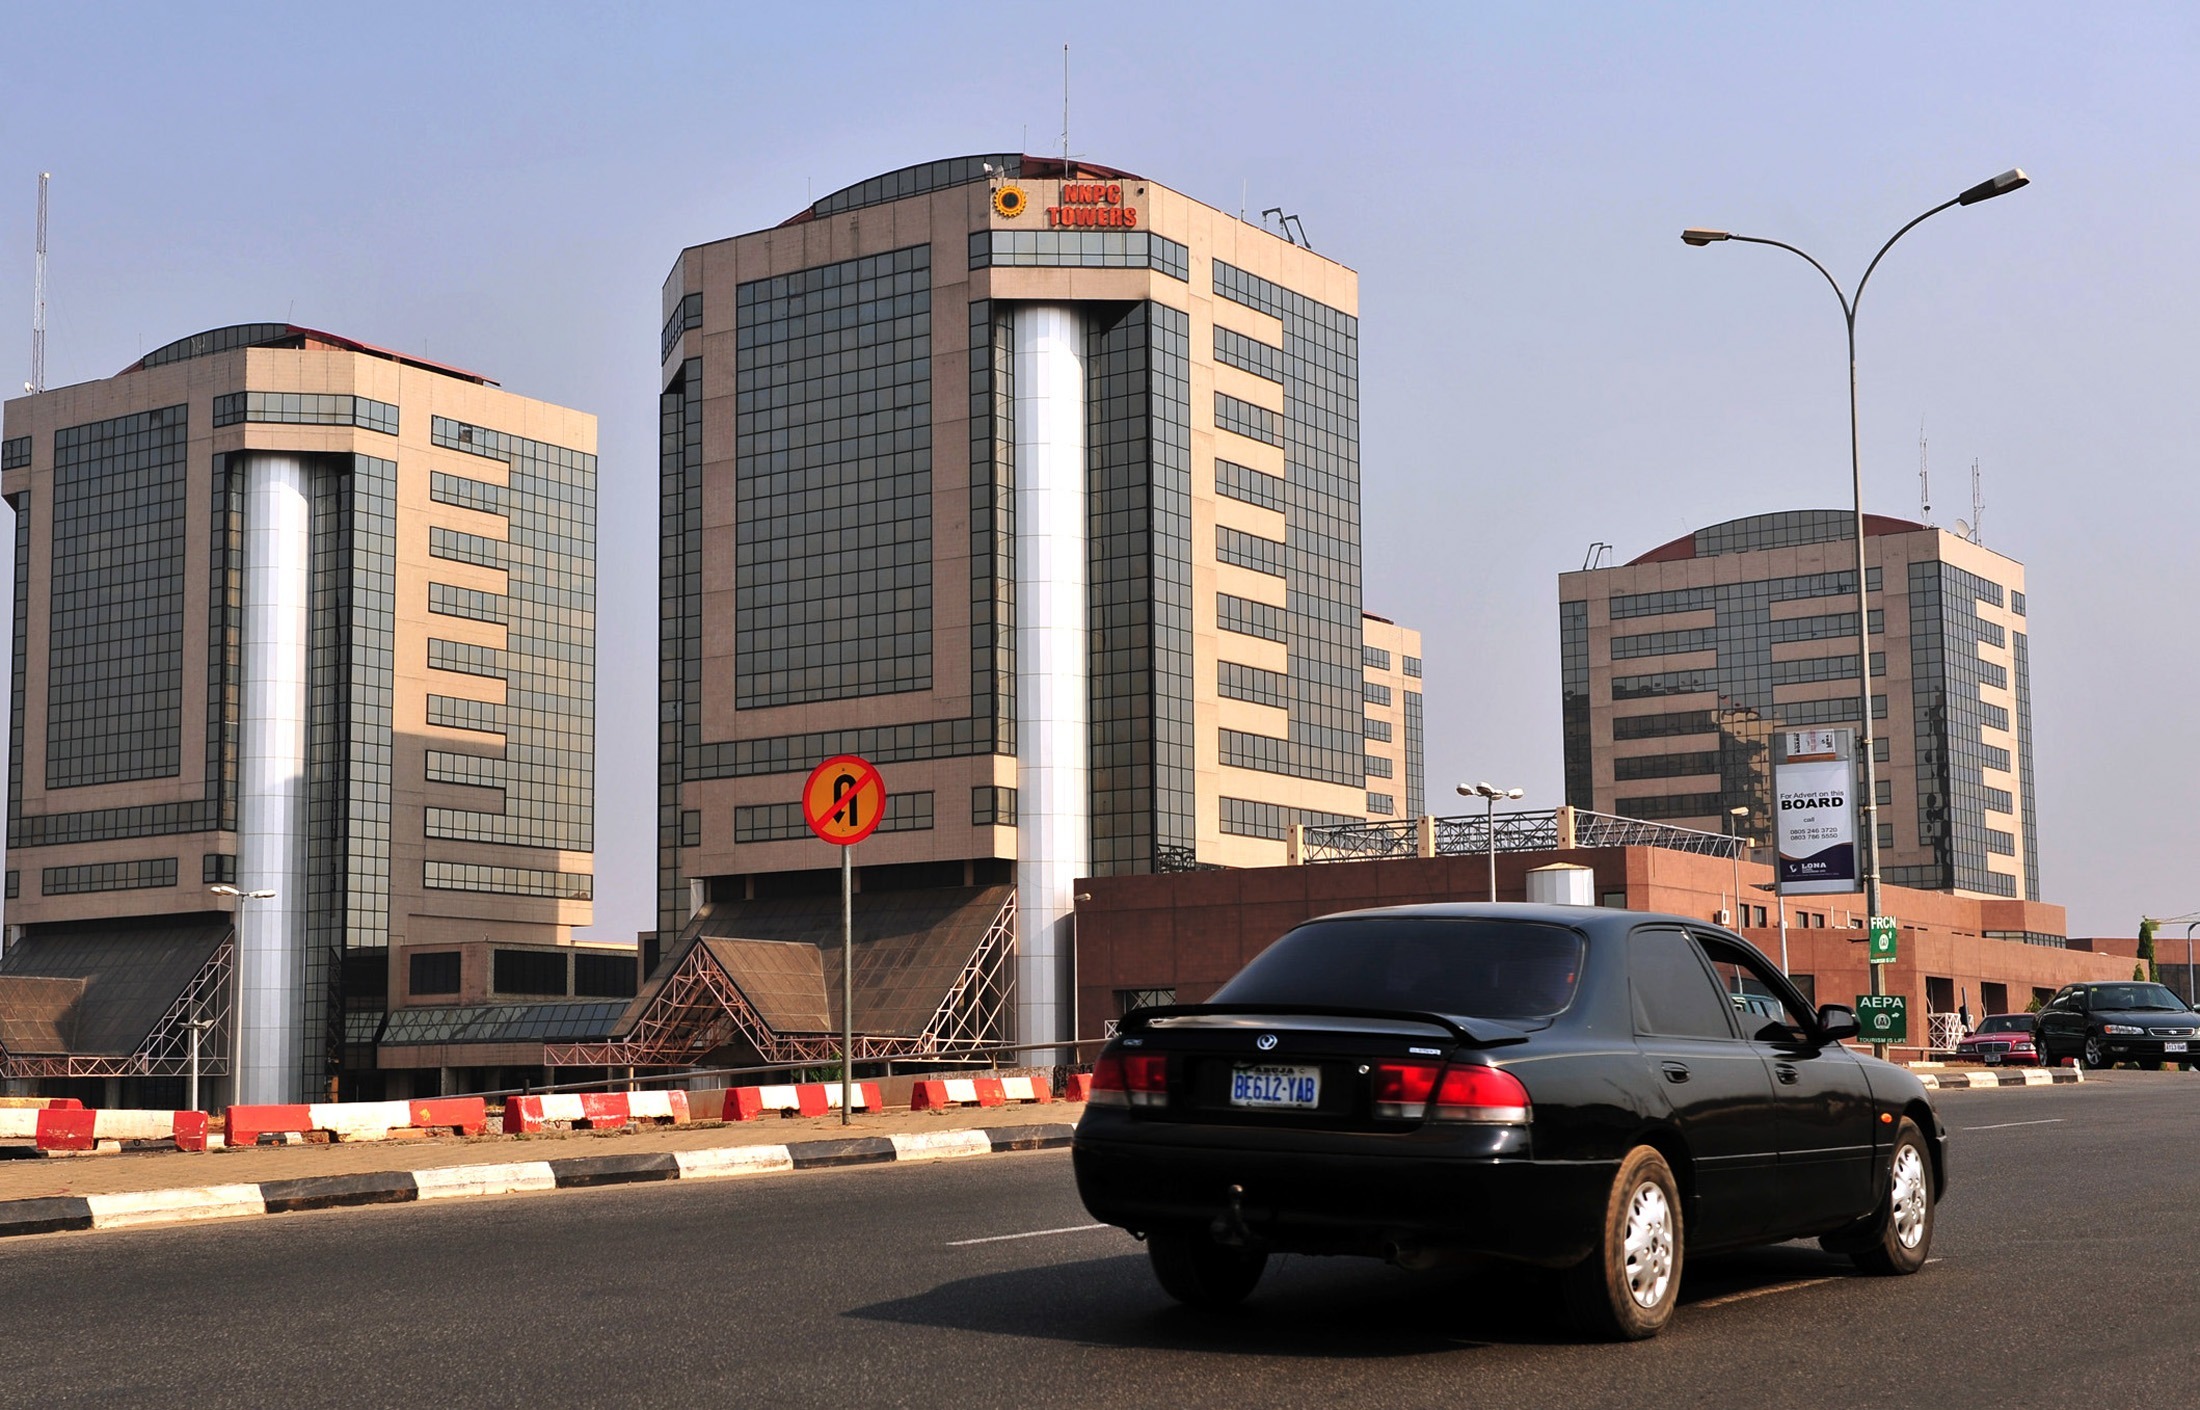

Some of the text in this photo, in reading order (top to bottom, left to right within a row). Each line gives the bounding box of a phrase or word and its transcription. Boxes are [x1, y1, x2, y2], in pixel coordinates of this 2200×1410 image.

[1063, 184, 1121, 204] NNPC
[1047, 206, 1137, 227] TOWERS
[1781, 797, 1844, 810] BOARD
[1870, 916, 1897, 929] FRCN
[1860, 997, 1903, 1008] AEPA
[1234, 1074, 1315, 1103] BE612-YAB
